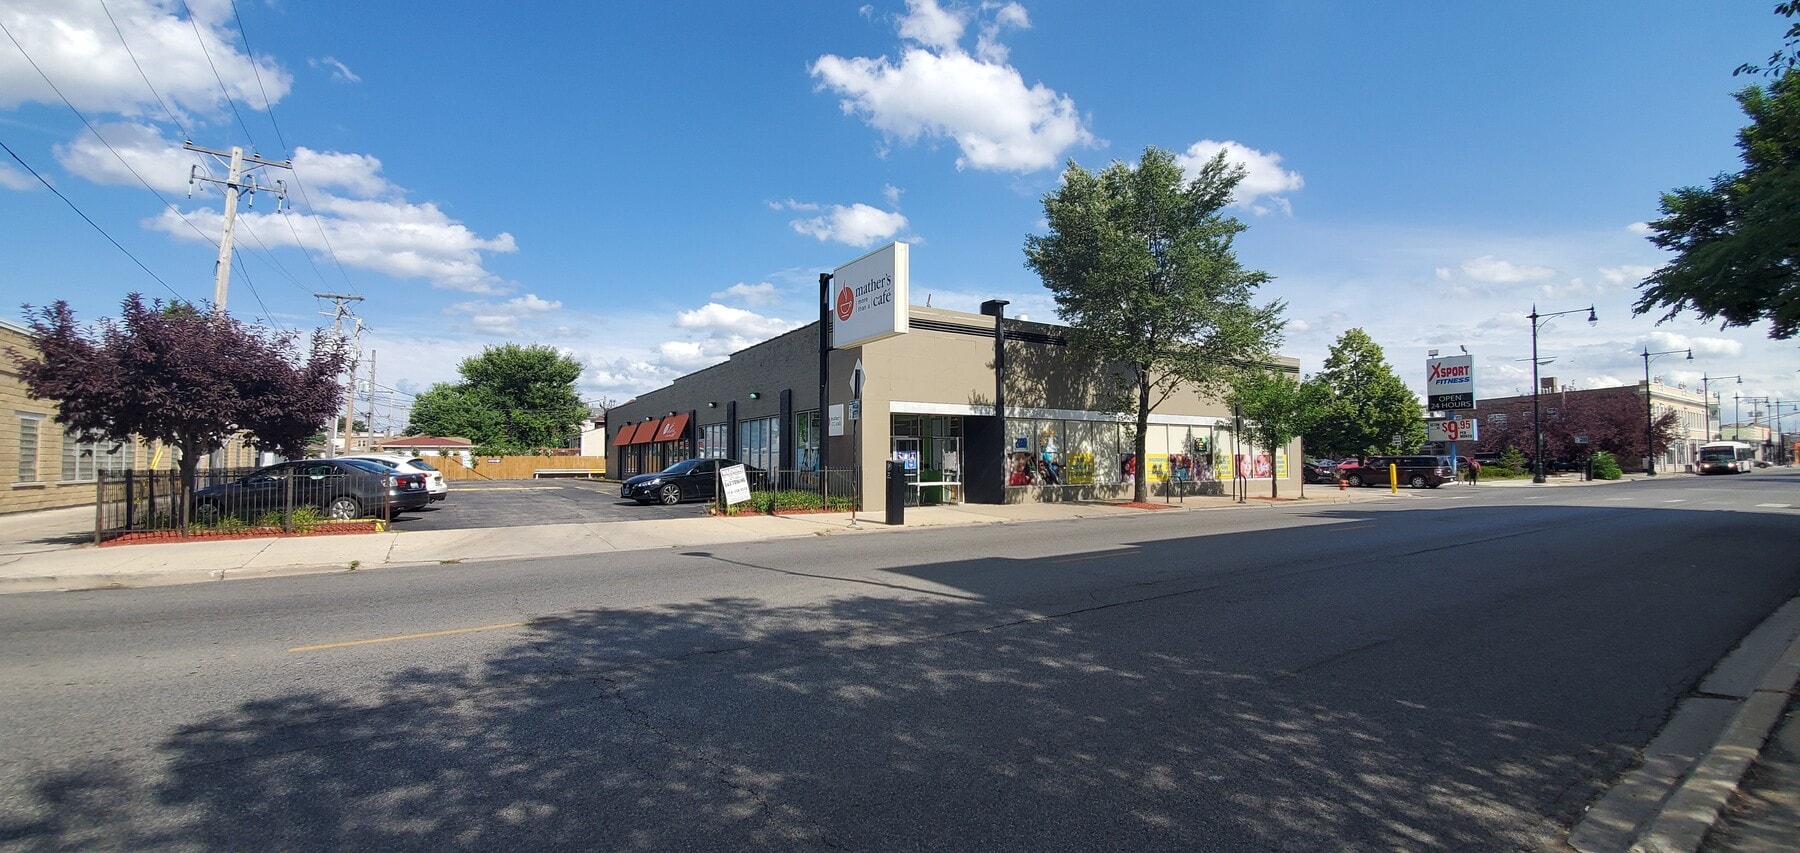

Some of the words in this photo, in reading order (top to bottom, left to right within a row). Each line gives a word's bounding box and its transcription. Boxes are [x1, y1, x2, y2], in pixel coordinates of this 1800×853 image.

[855, 273, 892, 298] mather's
[873, 288, 892, 307] café
[1429, 362, 1470, 382] XSPORT
[1436, 376, 1470, 385] FITNESS
[1439, 394, 1462, 403] OPEN
[1441, 400, 1472, 409] HOURS
